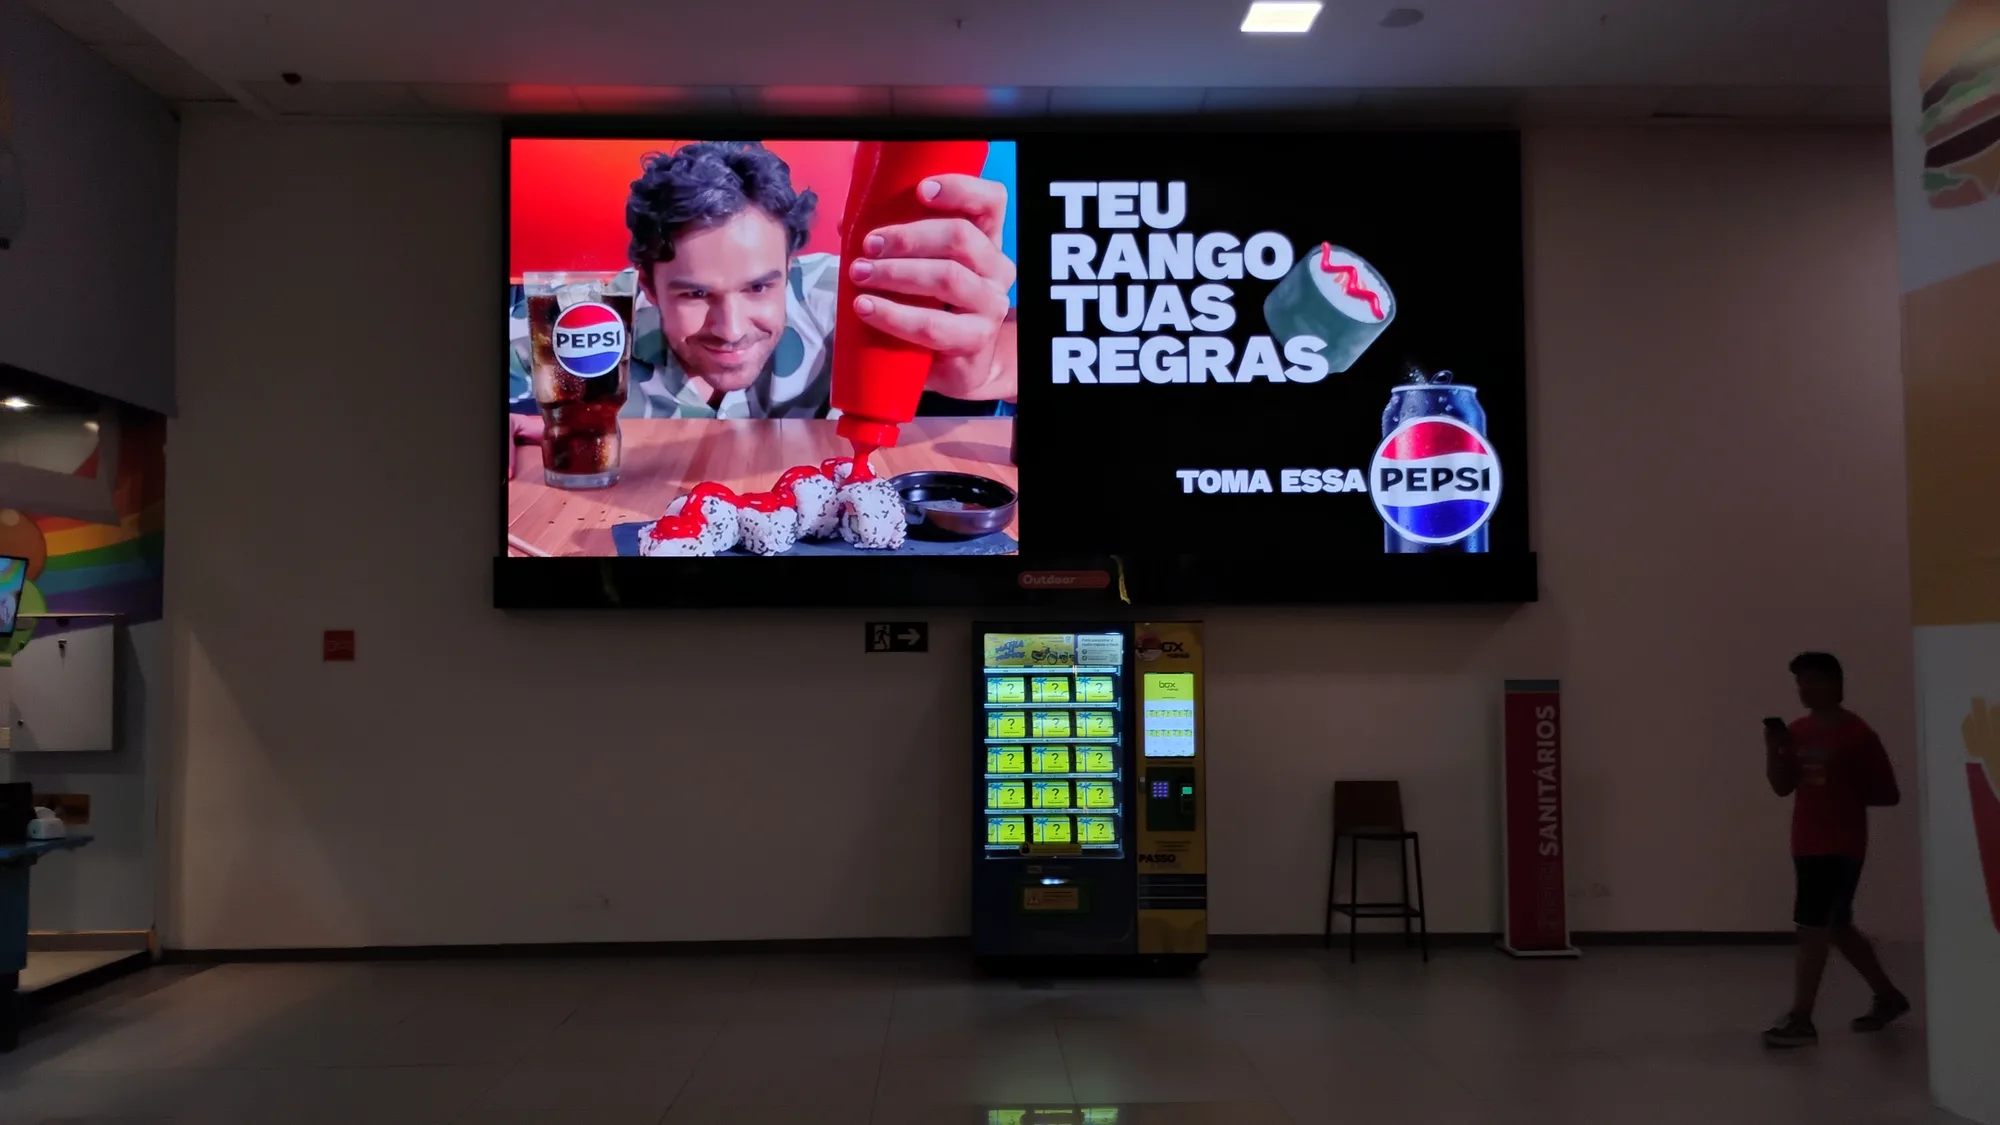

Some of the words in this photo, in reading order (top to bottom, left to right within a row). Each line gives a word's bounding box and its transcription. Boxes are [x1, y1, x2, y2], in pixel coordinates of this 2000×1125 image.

[1050, 181, 1187, 229] TEU
[1051, 231, 1294, 280] RANGO
[1050, 284, 1237, 332] TUAS
[556, 330, 620, 349] PEPSI
[1052, 335, 1329, 384] REGRAS
[1176, 469, 1273, 493] TOMA
[1281, 469, 1367, 493] ESSA
[1380, 467, 1491, 492] PEPSI
[1022, 574, 1075, 585] Outdoor
[1532, 705, 1559, 856] SANITÁRIOS
[1139, 853, 1176, 864] PASSO
